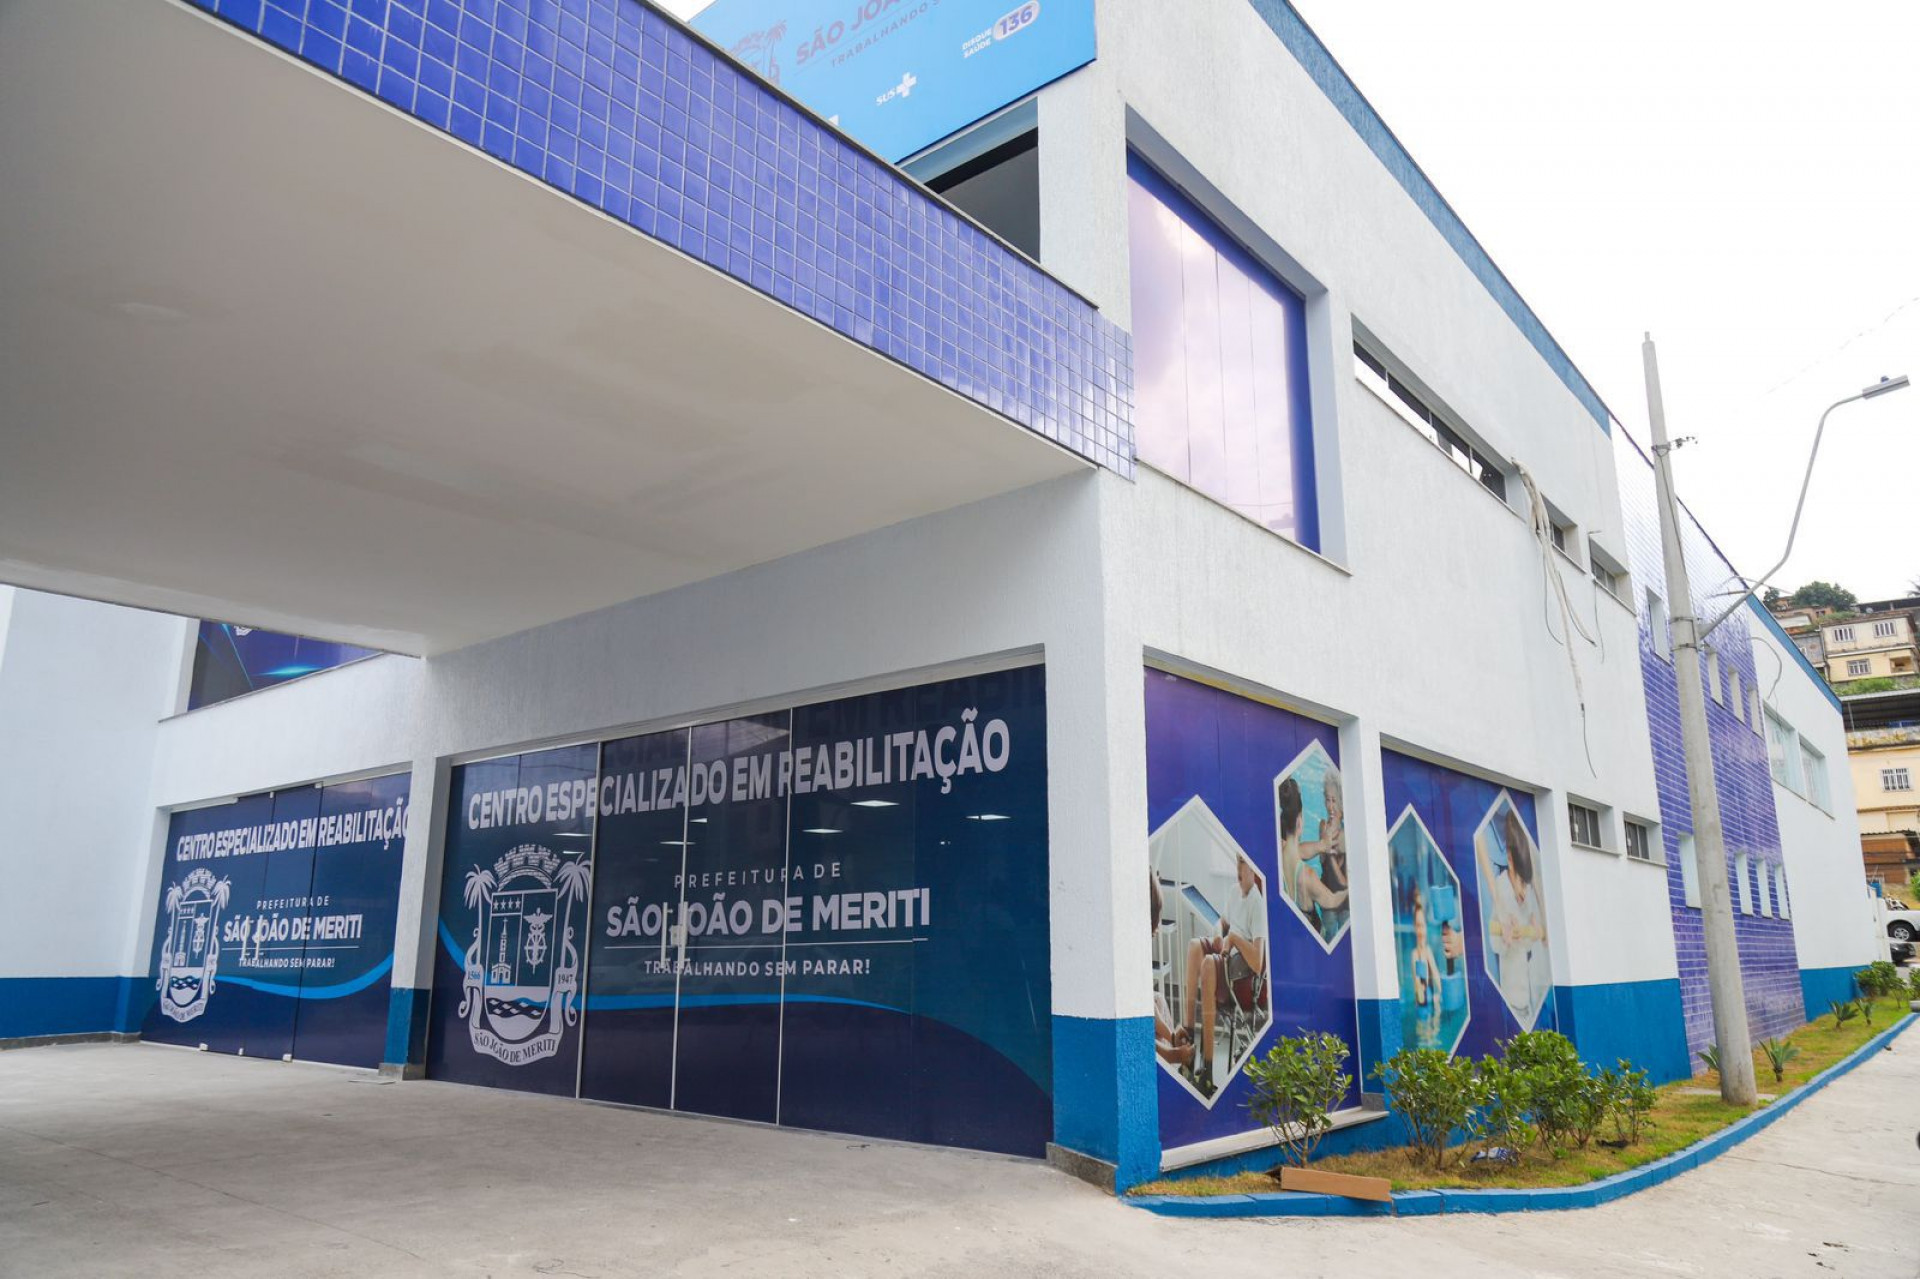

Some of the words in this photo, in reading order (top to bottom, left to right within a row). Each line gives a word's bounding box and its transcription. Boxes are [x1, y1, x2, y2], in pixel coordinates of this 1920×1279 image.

[831, 2, 929, 68] TRABALHANDO
[1000, 5, 1033, 36] 136
[796, 20, 845, 65] SÃO
[876, 88, 896, 105] SUS
[468, 785, 542, 830] CENTRO
[545, 759, 728, 821] ESPECIALIZADO
[732, 753, 771, 801] EM
[777, 706, 1010, 796] REABILITAÇÃO
[177, 832, 214, 861] CENTRO
[214, 820, 299, 858] ESPECIALIZADO
[299, 817, 318, 848] EM
[318, 797, 408, 850] REABILITAÇÃO
[673, 865, 804, 889] PREFEITURA
[813, 862, 841, 879] DE
[256, 896, 314, 910] PREFEITURA
[316, 895, 330, 907] DE
[606, 896, 663, 937] SÃO
[761, 896, 803, 934] DE
[812, 887, 930, 931] MERITI
[223, 914, 251, 942] SÃO
[290, 917, 312, 941] DE
[314, 914, 362, 939] MERITI
[305, 957, 336, 968] PARAR!
[644, 960, 760, 977] TRABALHANDO
[764, 960, 797, 977] SEM
[802, 958, 871, 976] PARAR!
[475, 1033, 489, 1046] SÃO
[510, 1051, 521, 1062] DE
[523, 1039, 556, 1057] MERITI
